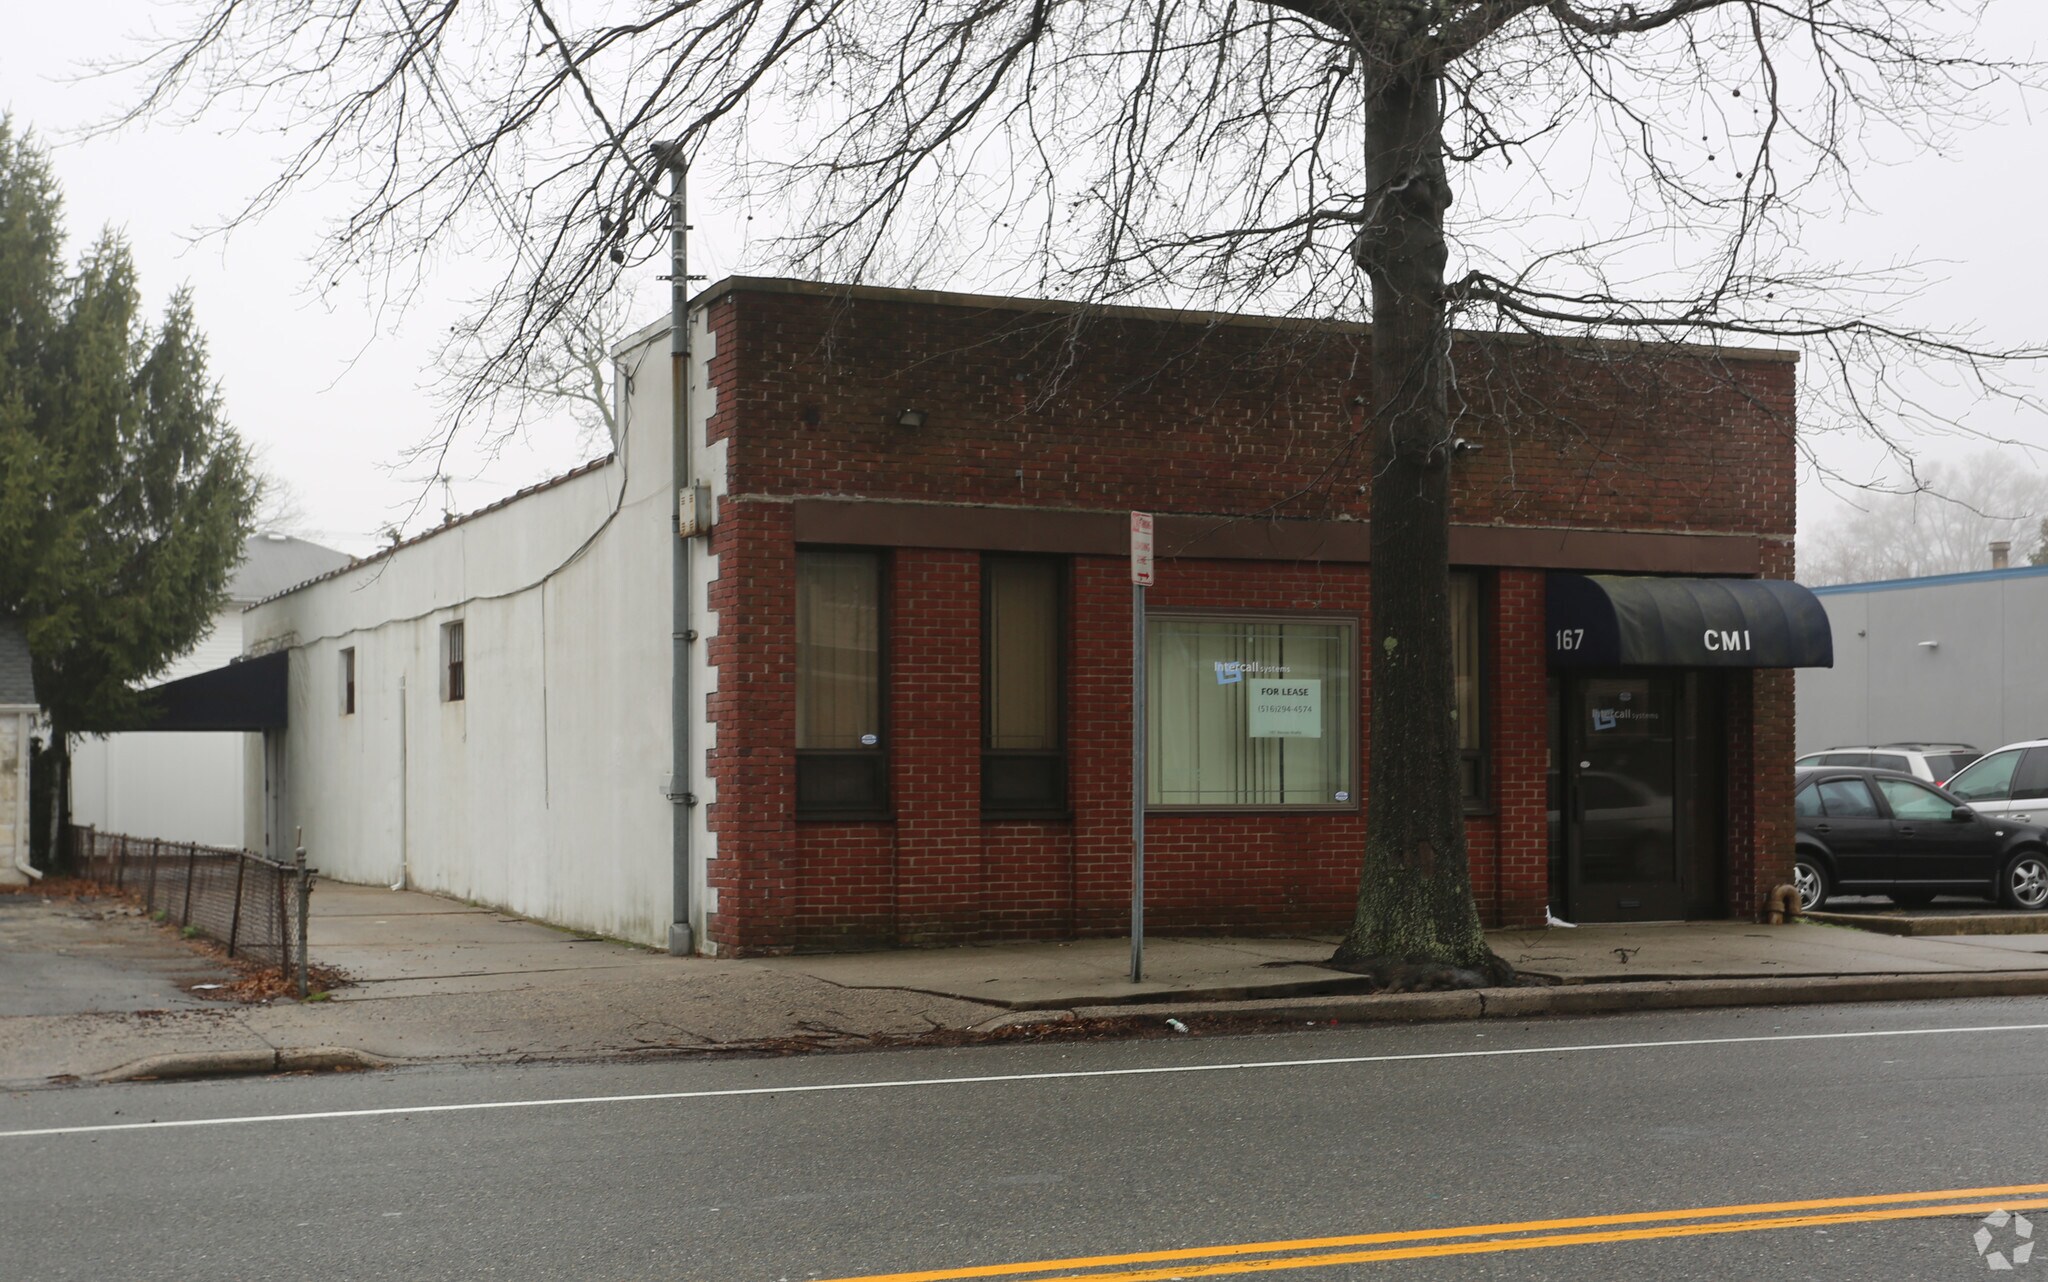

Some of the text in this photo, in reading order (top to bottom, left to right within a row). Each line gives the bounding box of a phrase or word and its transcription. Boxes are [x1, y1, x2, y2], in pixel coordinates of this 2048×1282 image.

[1556, 628, 1584, 650] 167
[1703, 629, 1751, 651] CMI
[1214, 661, 1291, 674] Intercall systems
[1261, 687, 1309, 696] FOR LEASE
